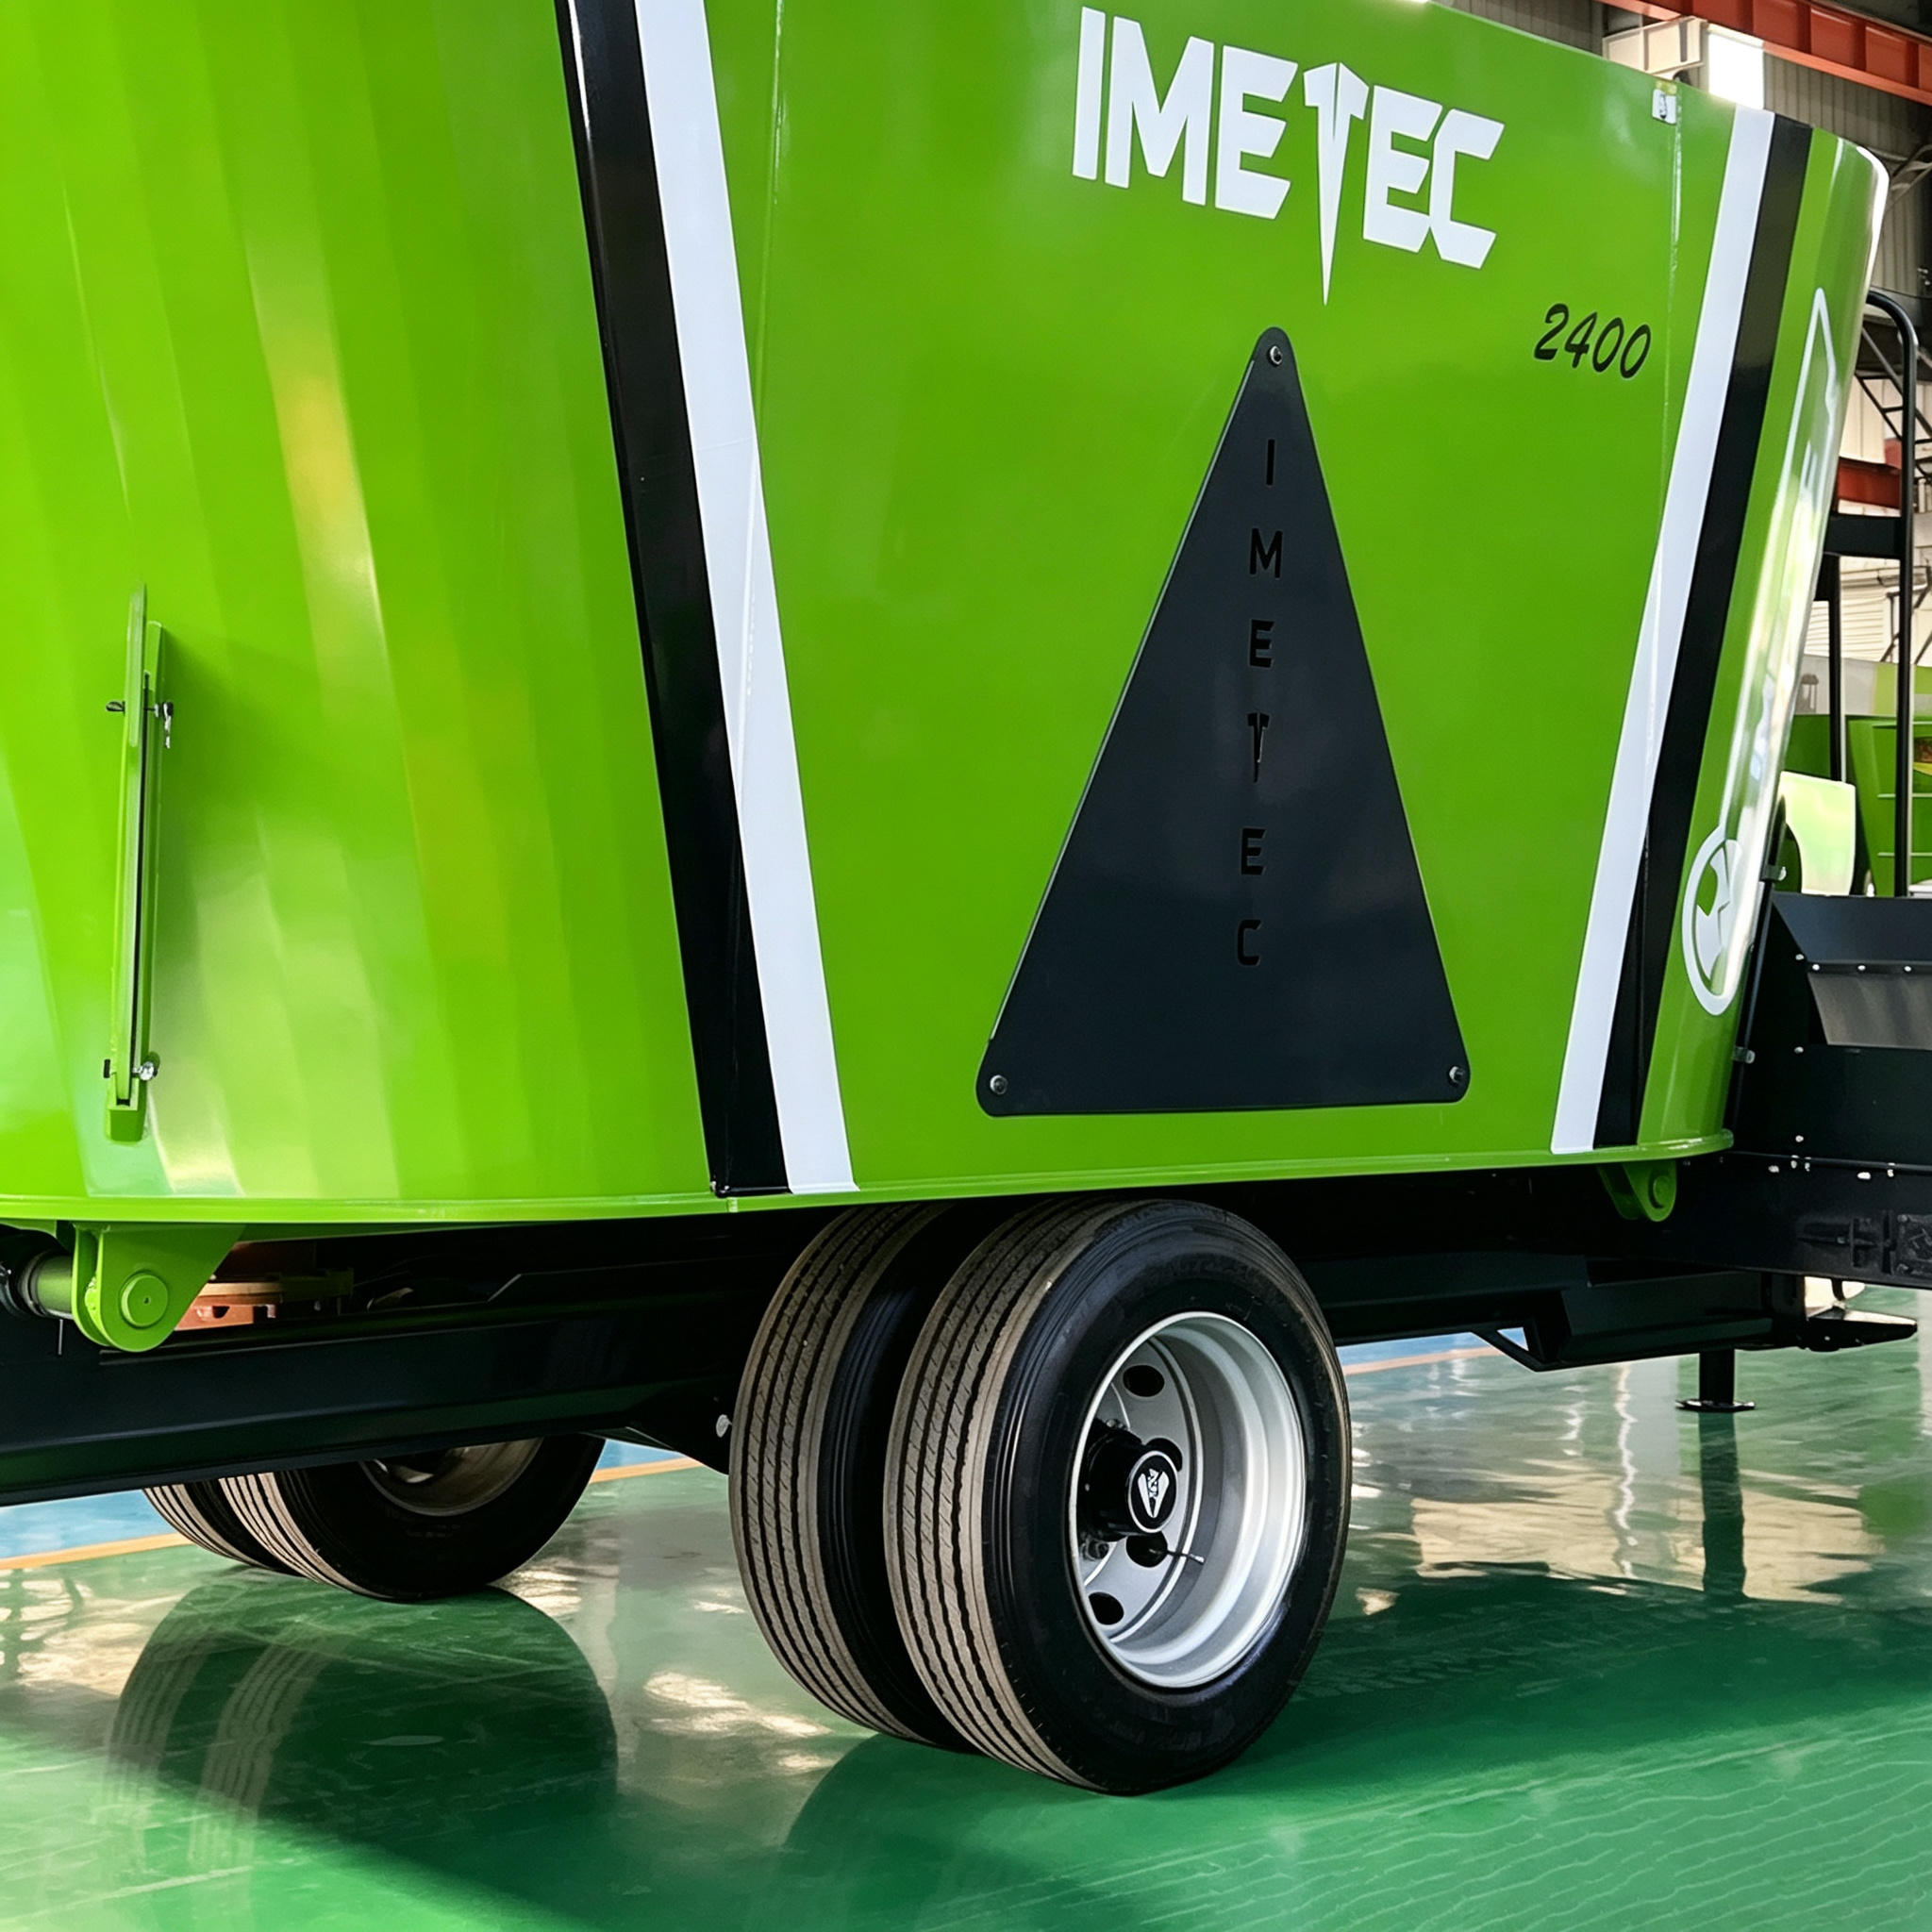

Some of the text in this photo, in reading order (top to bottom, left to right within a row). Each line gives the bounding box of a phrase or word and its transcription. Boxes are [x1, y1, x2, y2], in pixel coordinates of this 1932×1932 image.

[1072, 7, 1505, 306] IMETEC
[1534, 303, 1651, 379] 2400
[1237, 439, 1283, 966] IMETEC
